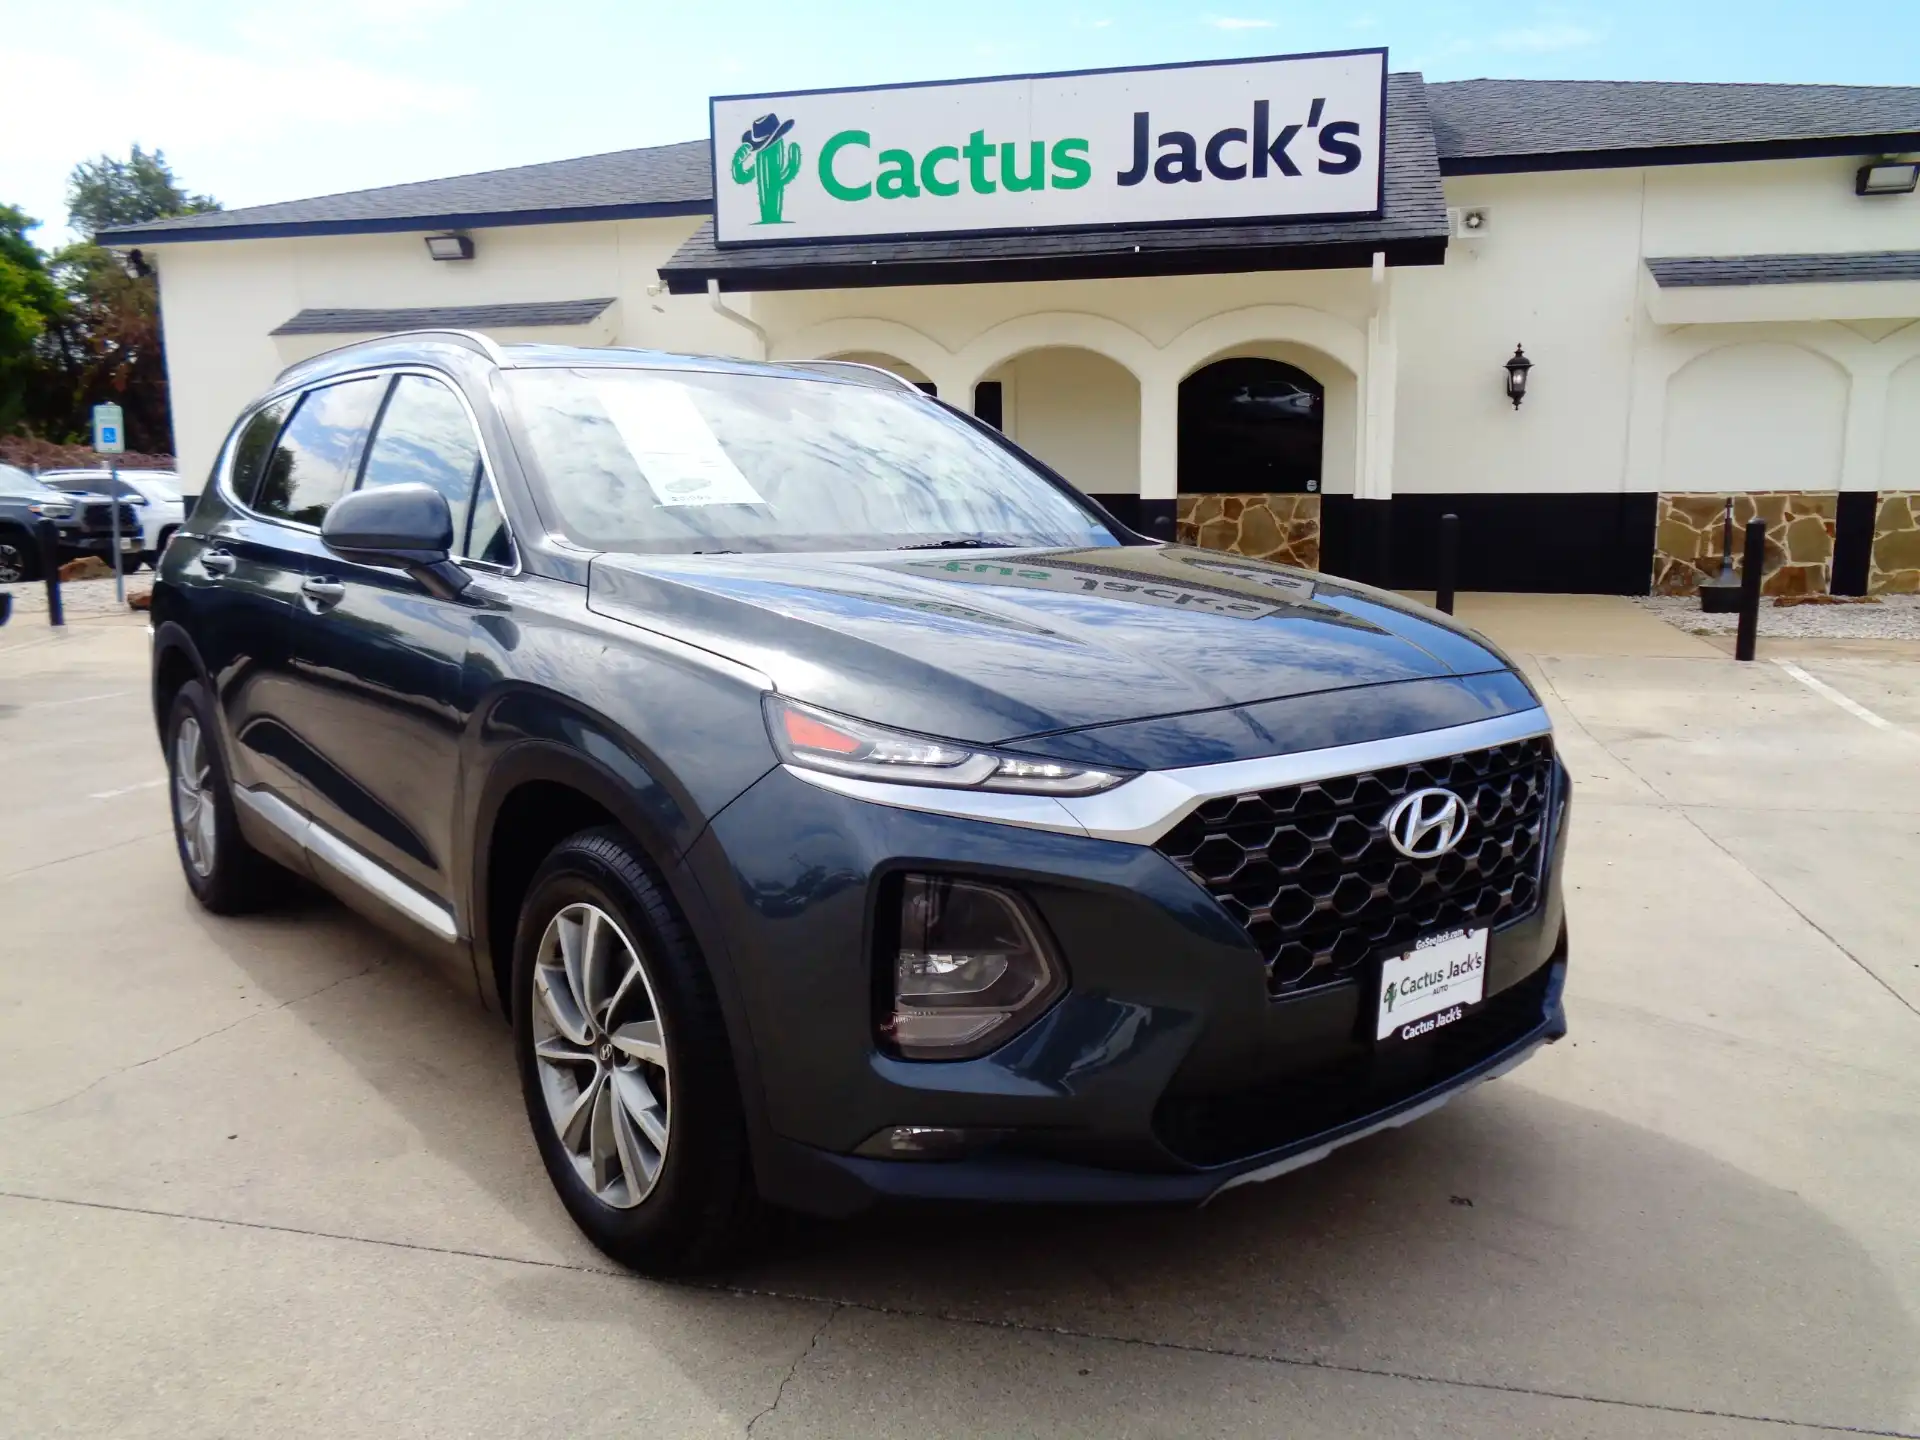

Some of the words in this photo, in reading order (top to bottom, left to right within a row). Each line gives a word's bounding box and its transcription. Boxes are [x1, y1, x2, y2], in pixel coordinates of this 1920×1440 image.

[818, 129, 1091, 201] Cactus
[1116, 97, 1362, 188] Jack's
[1400, 969, 1444, 996] Cactus
[1447, 952, 1482, 979] Jack's
[1433, 984, 1448, 995] AUTO
[1402, 1019, 1434, 1040] Cactus
[1436, 1006, 1461, 1028] Jack's
